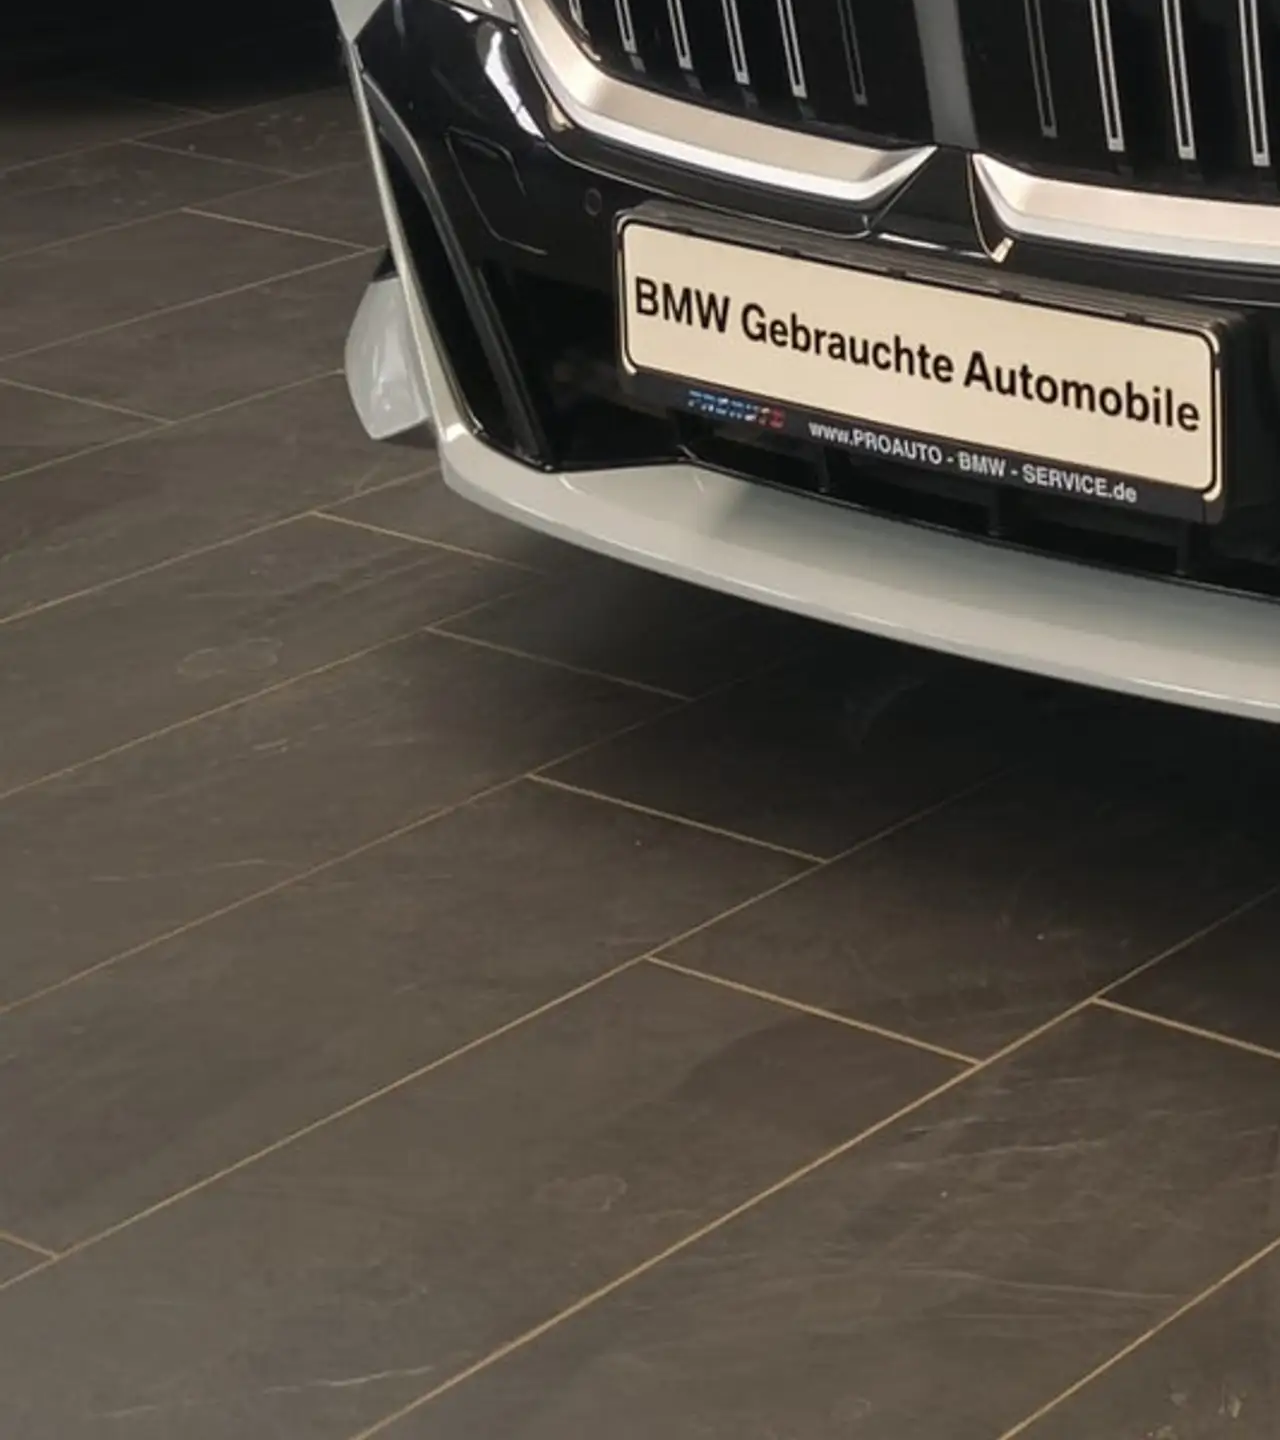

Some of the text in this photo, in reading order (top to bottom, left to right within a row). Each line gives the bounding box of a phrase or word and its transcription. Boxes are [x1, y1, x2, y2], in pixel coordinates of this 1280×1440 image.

[634, 275, 1201, 433] BMW Gebrauchte Automobile
[807, 421, 943, 466] www.PROAUTO
[957, 450, 1007, 479] BMW
[1021, 462, 1138, 504] SERVICE.de
